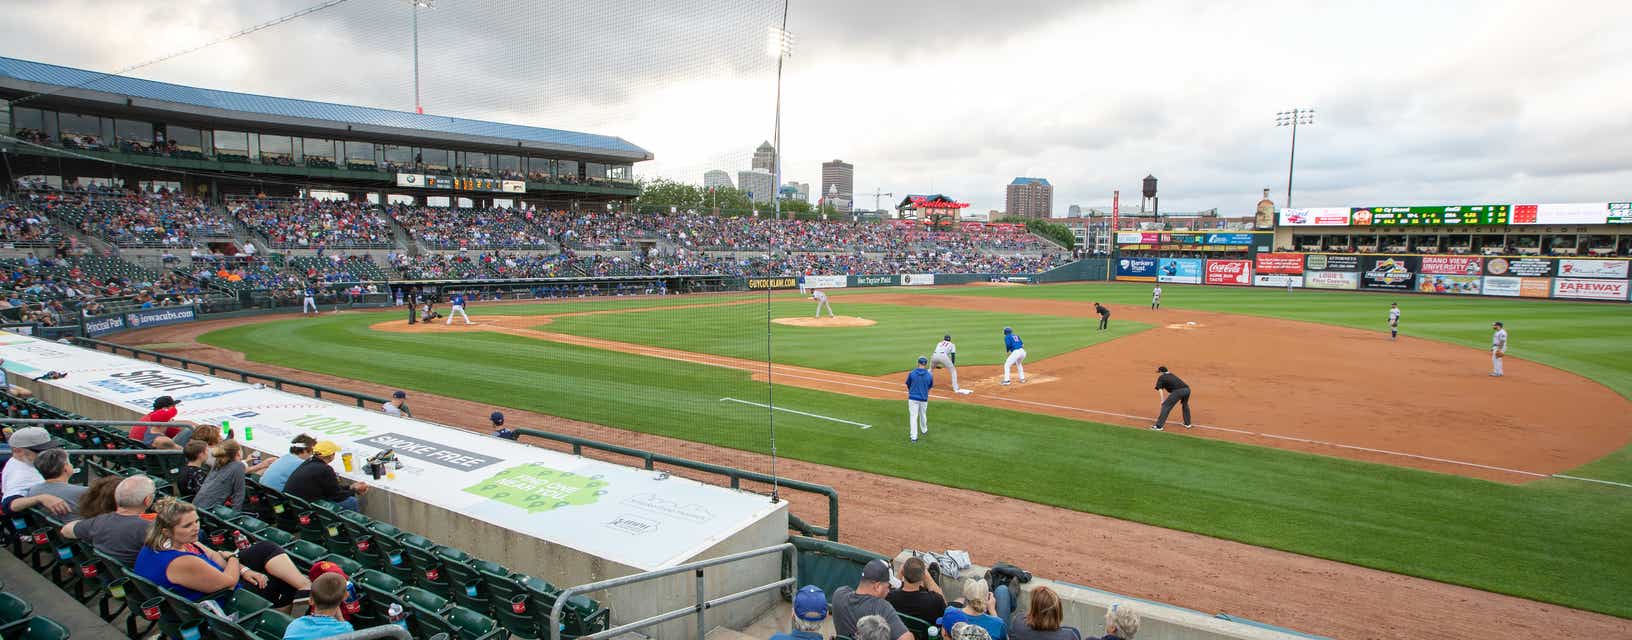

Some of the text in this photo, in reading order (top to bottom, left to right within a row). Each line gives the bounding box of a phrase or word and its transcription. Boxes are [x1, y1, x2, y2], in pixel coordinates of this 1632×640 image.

[910, 196, 970, 208] Budweiser
[1209, 262, 1241, 273] Coca-Cola
[1423, 263, 1466, 271] UNIVERSITY
[1559, 282, 1622, 291] FAREWAY
[141, 310, 193, 323] iowacubs.com
[86, 317, 122, 333] Principal Park
[110, 369, 210, 391] Smart
[370, 436, 486, 467] SMOKE FREE
